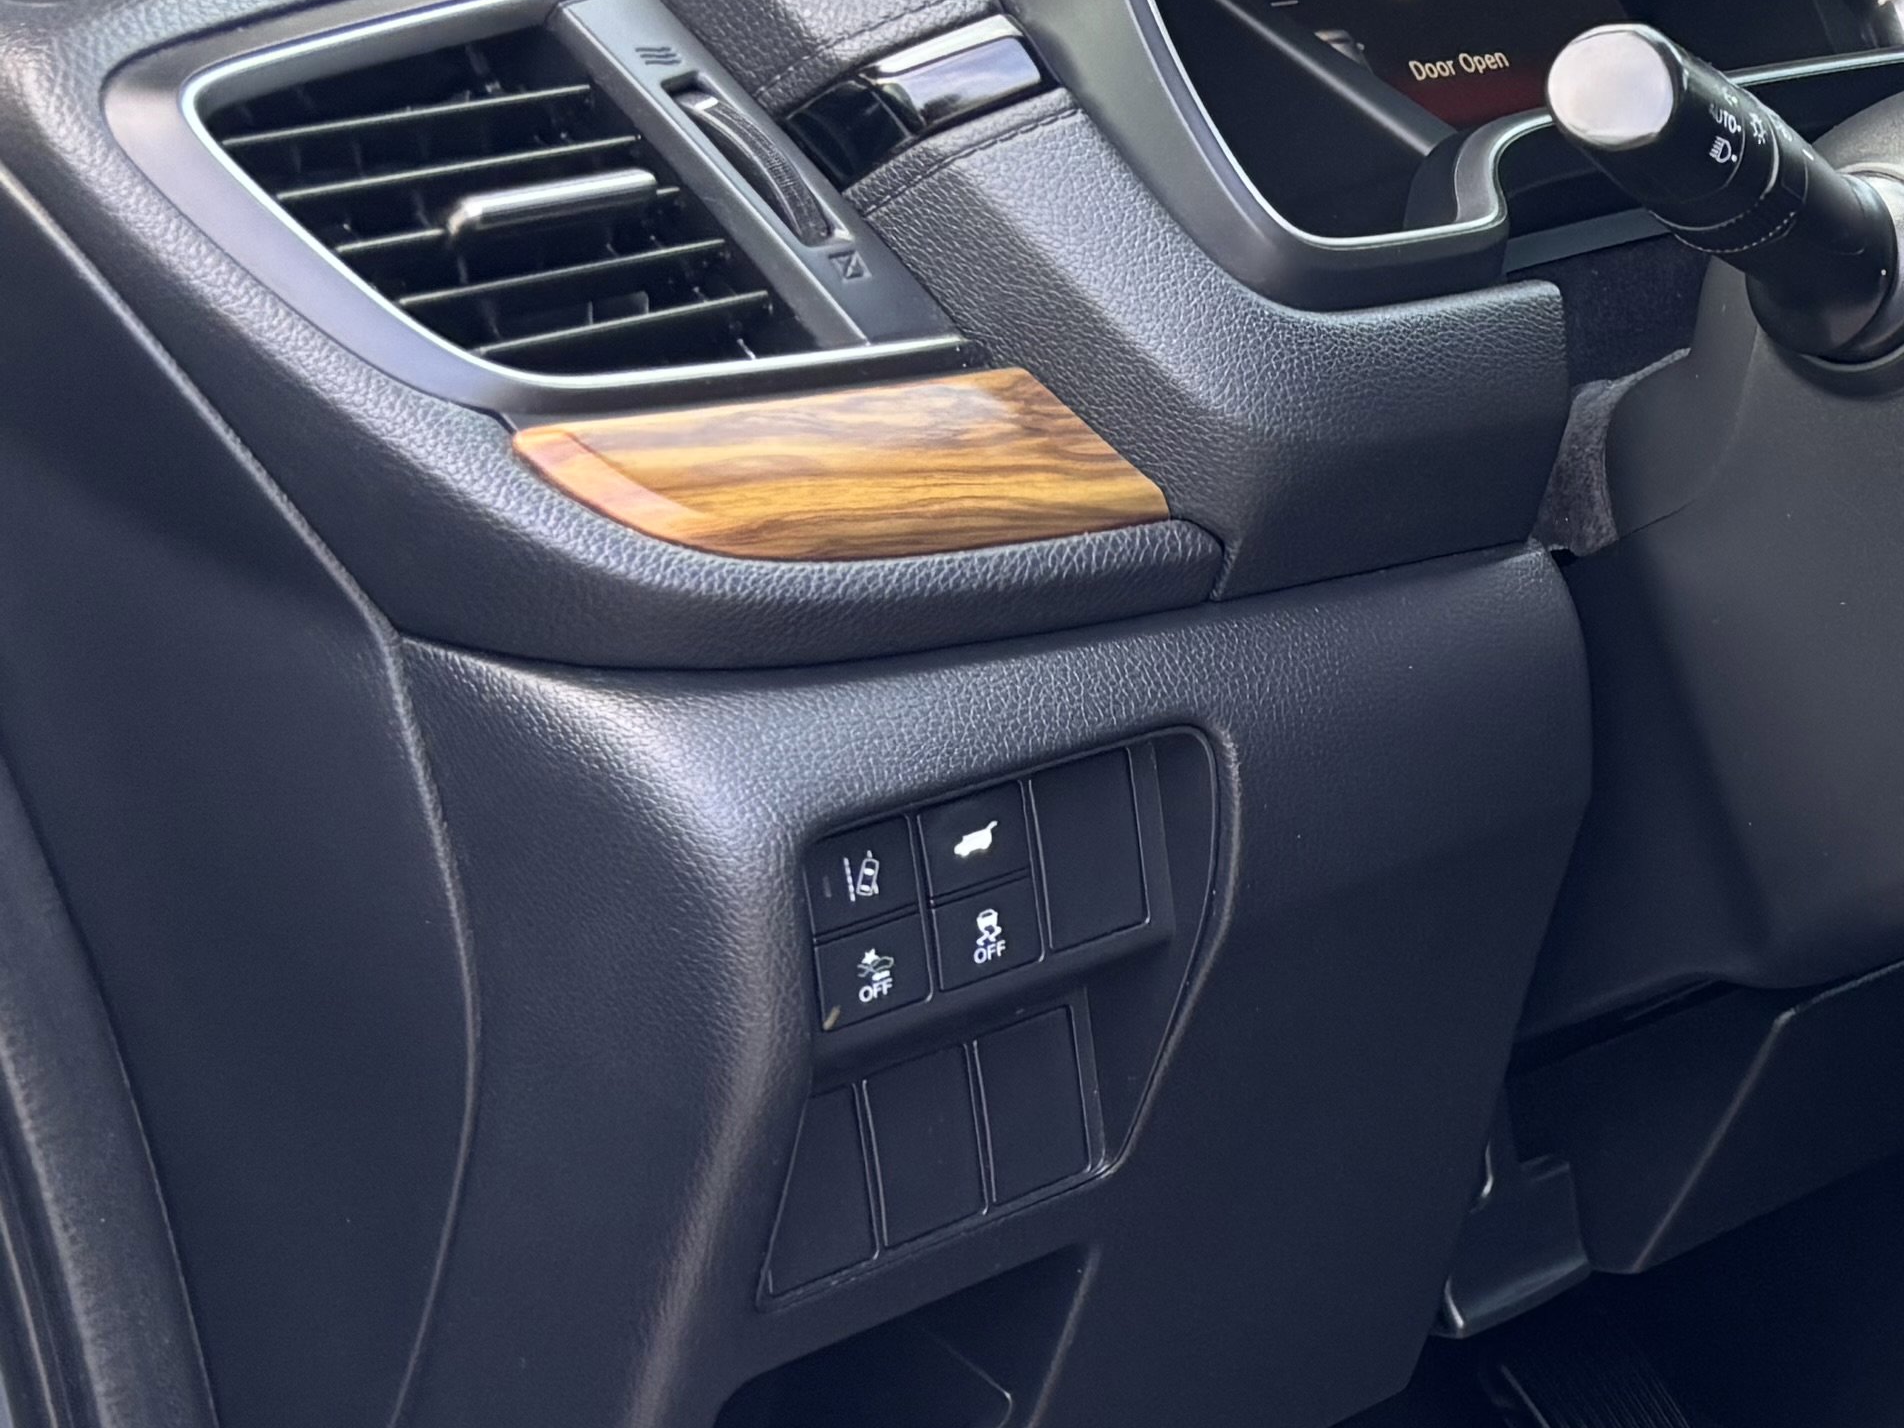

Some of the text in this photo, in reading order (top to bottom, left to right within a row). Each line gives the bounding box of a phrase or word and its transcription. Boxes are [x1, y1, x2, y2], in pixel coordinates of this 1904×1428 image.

[1408, 51, 1510, 82] Door Open
[974, 941, 1005, 963] OFF
[859, 978, 892, 1002] OFF
